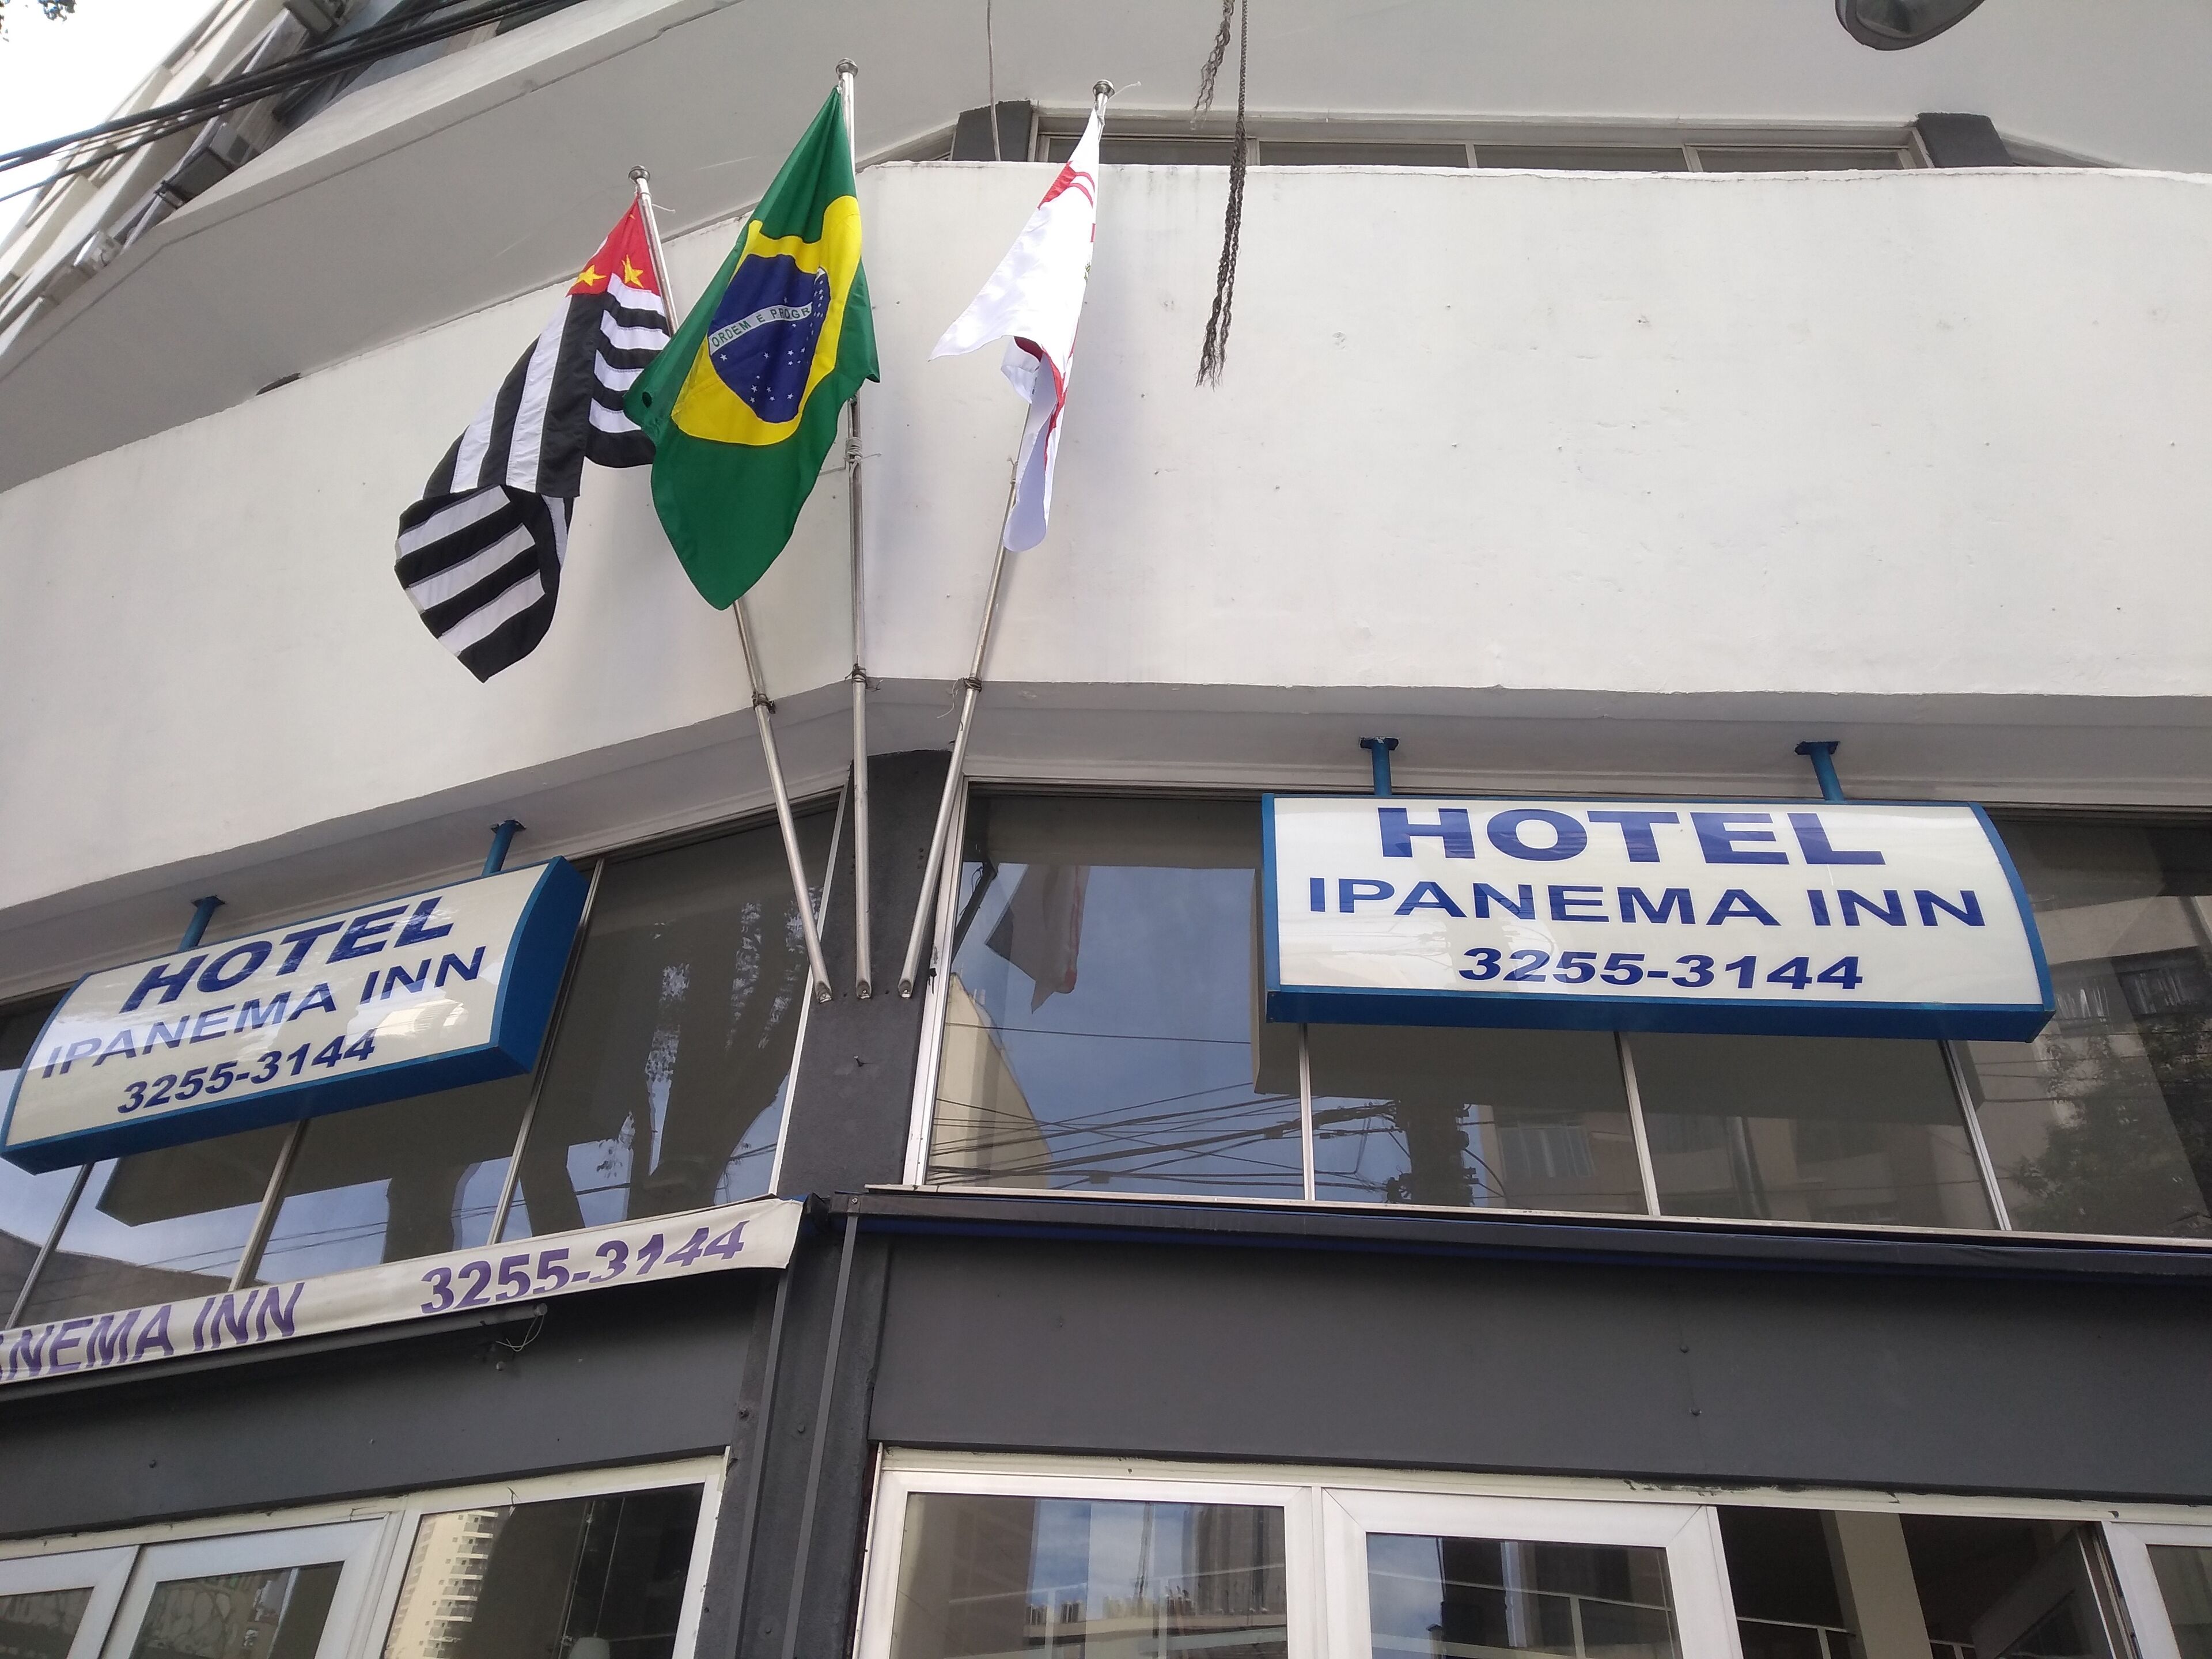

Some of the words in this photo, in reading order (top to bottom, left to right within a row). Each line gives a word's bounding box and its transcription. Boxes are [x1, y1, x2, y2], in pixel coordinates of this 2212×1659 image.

[711, 320, 752, 347] ORDEM
[756, 314, 766, 323] E
[1377, 807, 1886, 865] HOTEL
[1309, 876, 1783, 926] IPANEMA
[1806, 889, 1986, 926] INN
[119, 896, 454, 1013] HOTEL
[1459, 947, 1863, 990] 3255-3144
[41, 983, 336, 1078] IPANEMA
[360, 946, 485, 1005] INN
[118, 1028, 376, 1113] 3255-3144
[0, 1305, 174, 1381] NEMA
[193, 1282, 305, 1352] INN
[421, 1220, 750, 1314] 3255-3144
